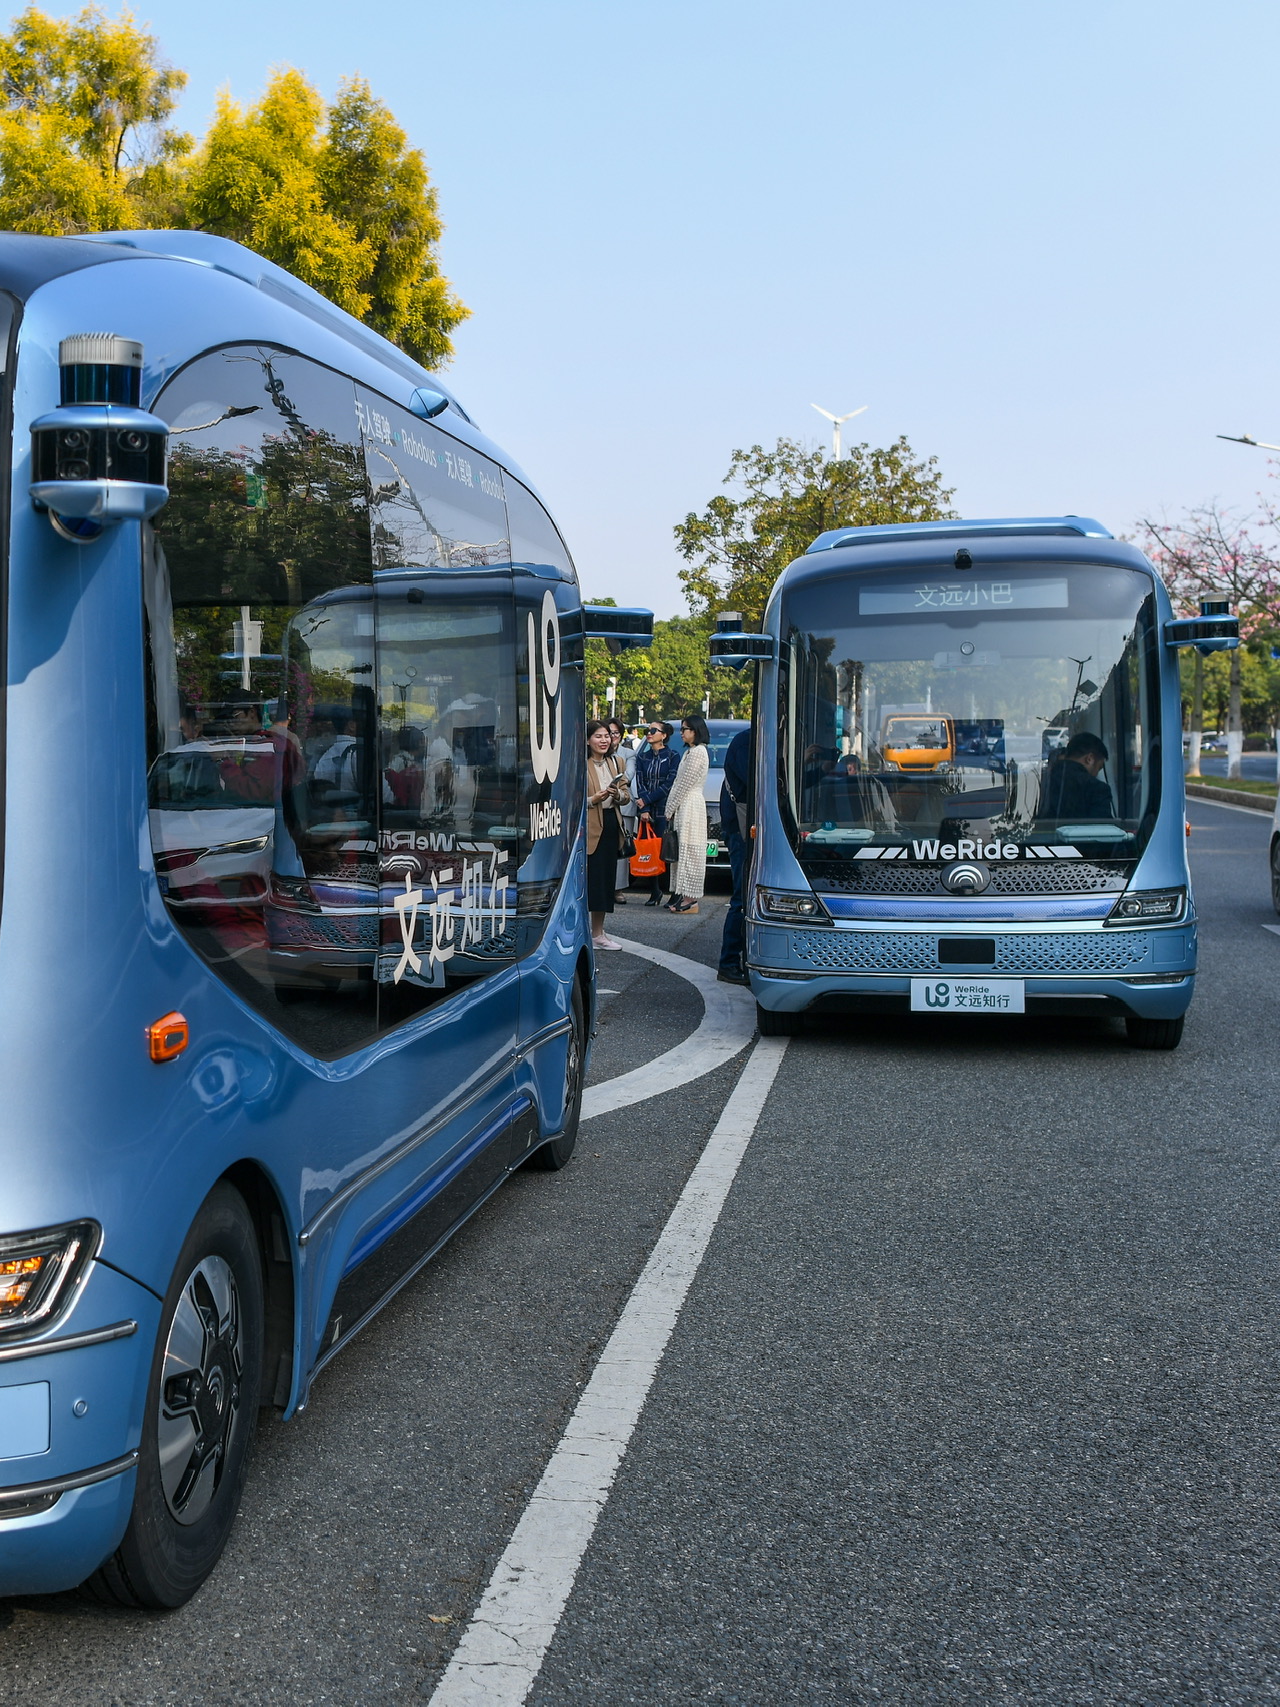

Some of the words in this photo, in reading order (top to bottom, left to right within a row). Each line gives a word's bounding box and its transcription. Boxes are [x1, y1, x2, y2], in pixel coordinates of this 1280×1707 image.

[355, 400, 393, 447] 无人驾驶
[401, 428, 438, 468] Robobus
[915, 582, 1014, 608] 文远小巴
[529, 799, 561, 841] WeRide
[912, 840, 1019, 861] WeRide
[393, 850, 509, 985] 文远知行
[955, 994, 1010, 1008] 文远知行
